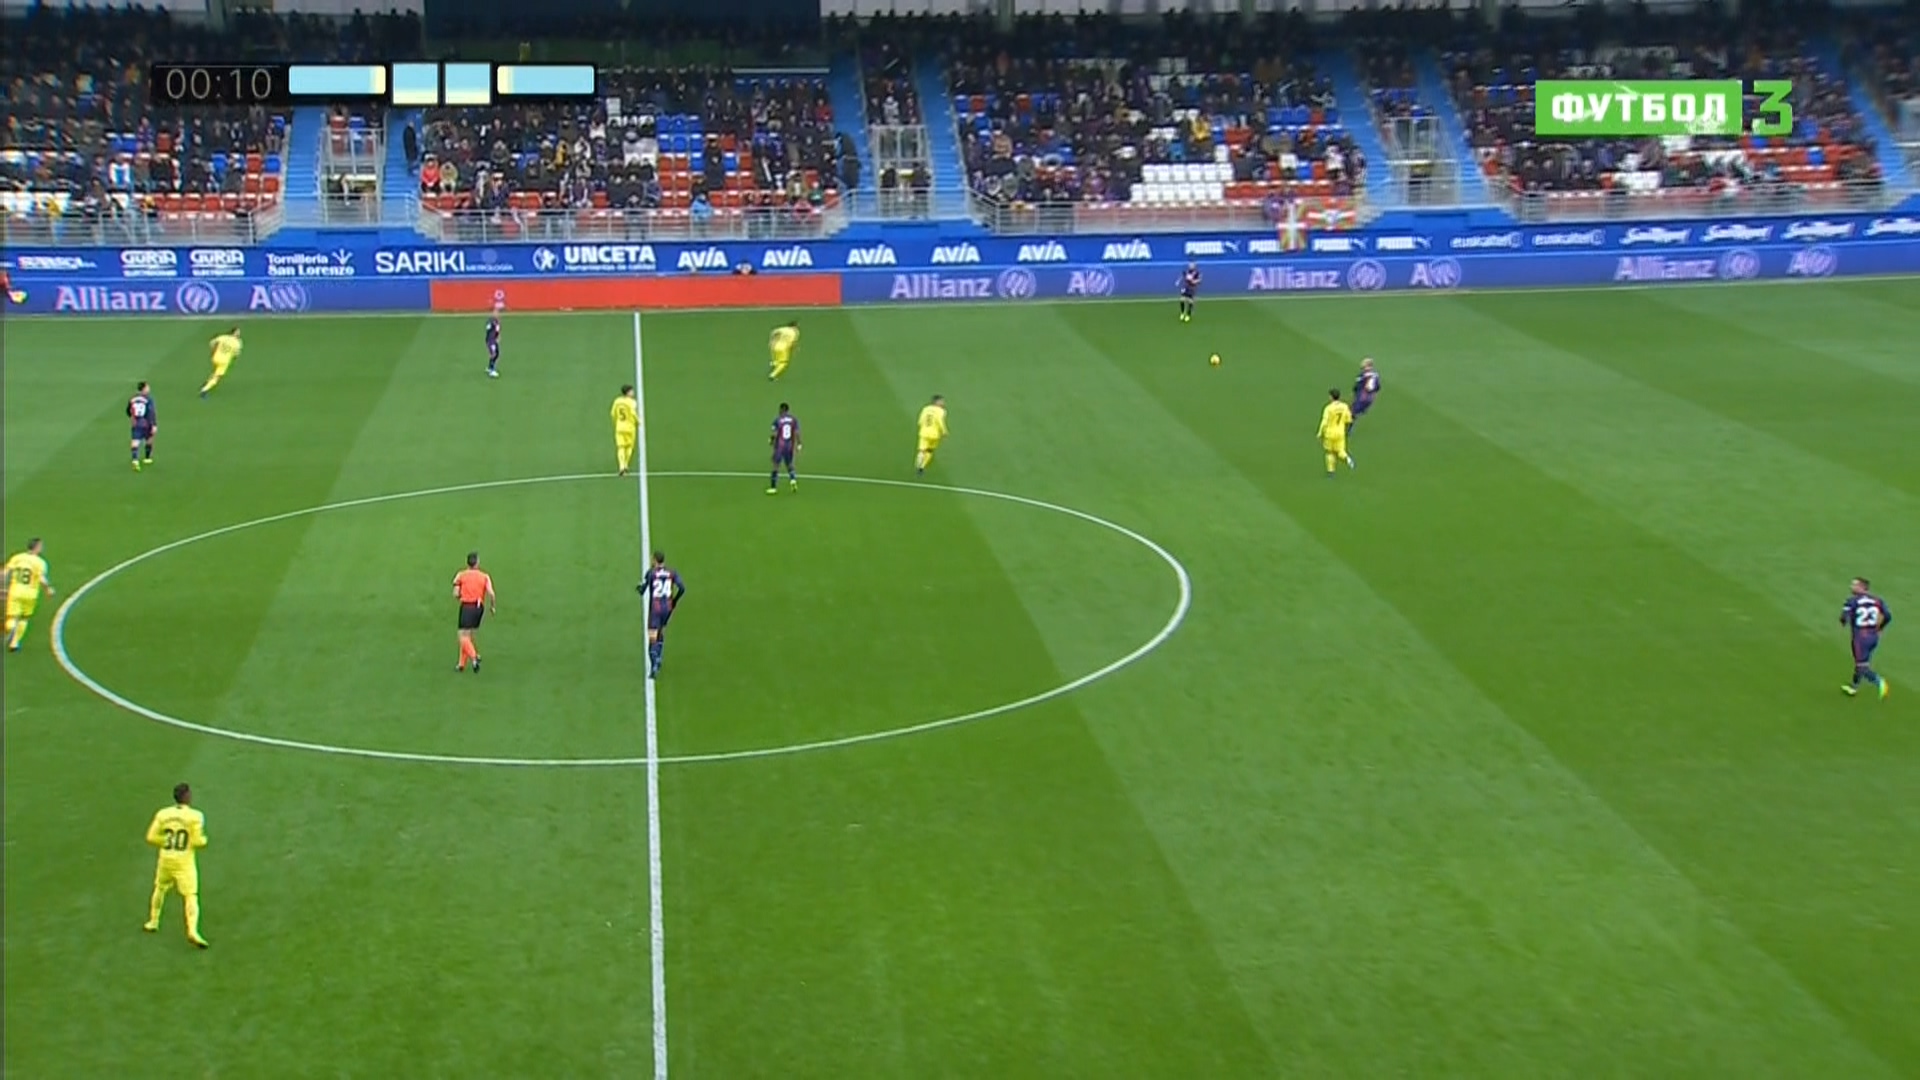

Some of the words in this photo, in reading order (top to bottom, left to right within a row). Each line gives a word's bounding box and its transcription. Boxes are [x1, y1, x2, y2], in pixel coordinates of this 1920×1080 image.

[375, 250, 465, 273] SARIKI
[564, 245, 656, 264] UNCETA
[268, 264, 296, 276] San
[298, 264, 355, 276] Lorenzo
[1247, 267, 1341, 290] Allianz
[890, 274, 994, 299] Allianz
[55, 286, 167, 311] Allianz
[618, 408, 627, 421] 5
[1334, 412, 1343, 424] 7
[652, 577, 673, 598] 24
[1856, 605, 1881, 627] 23
[163, 829, 189, 851] 30
